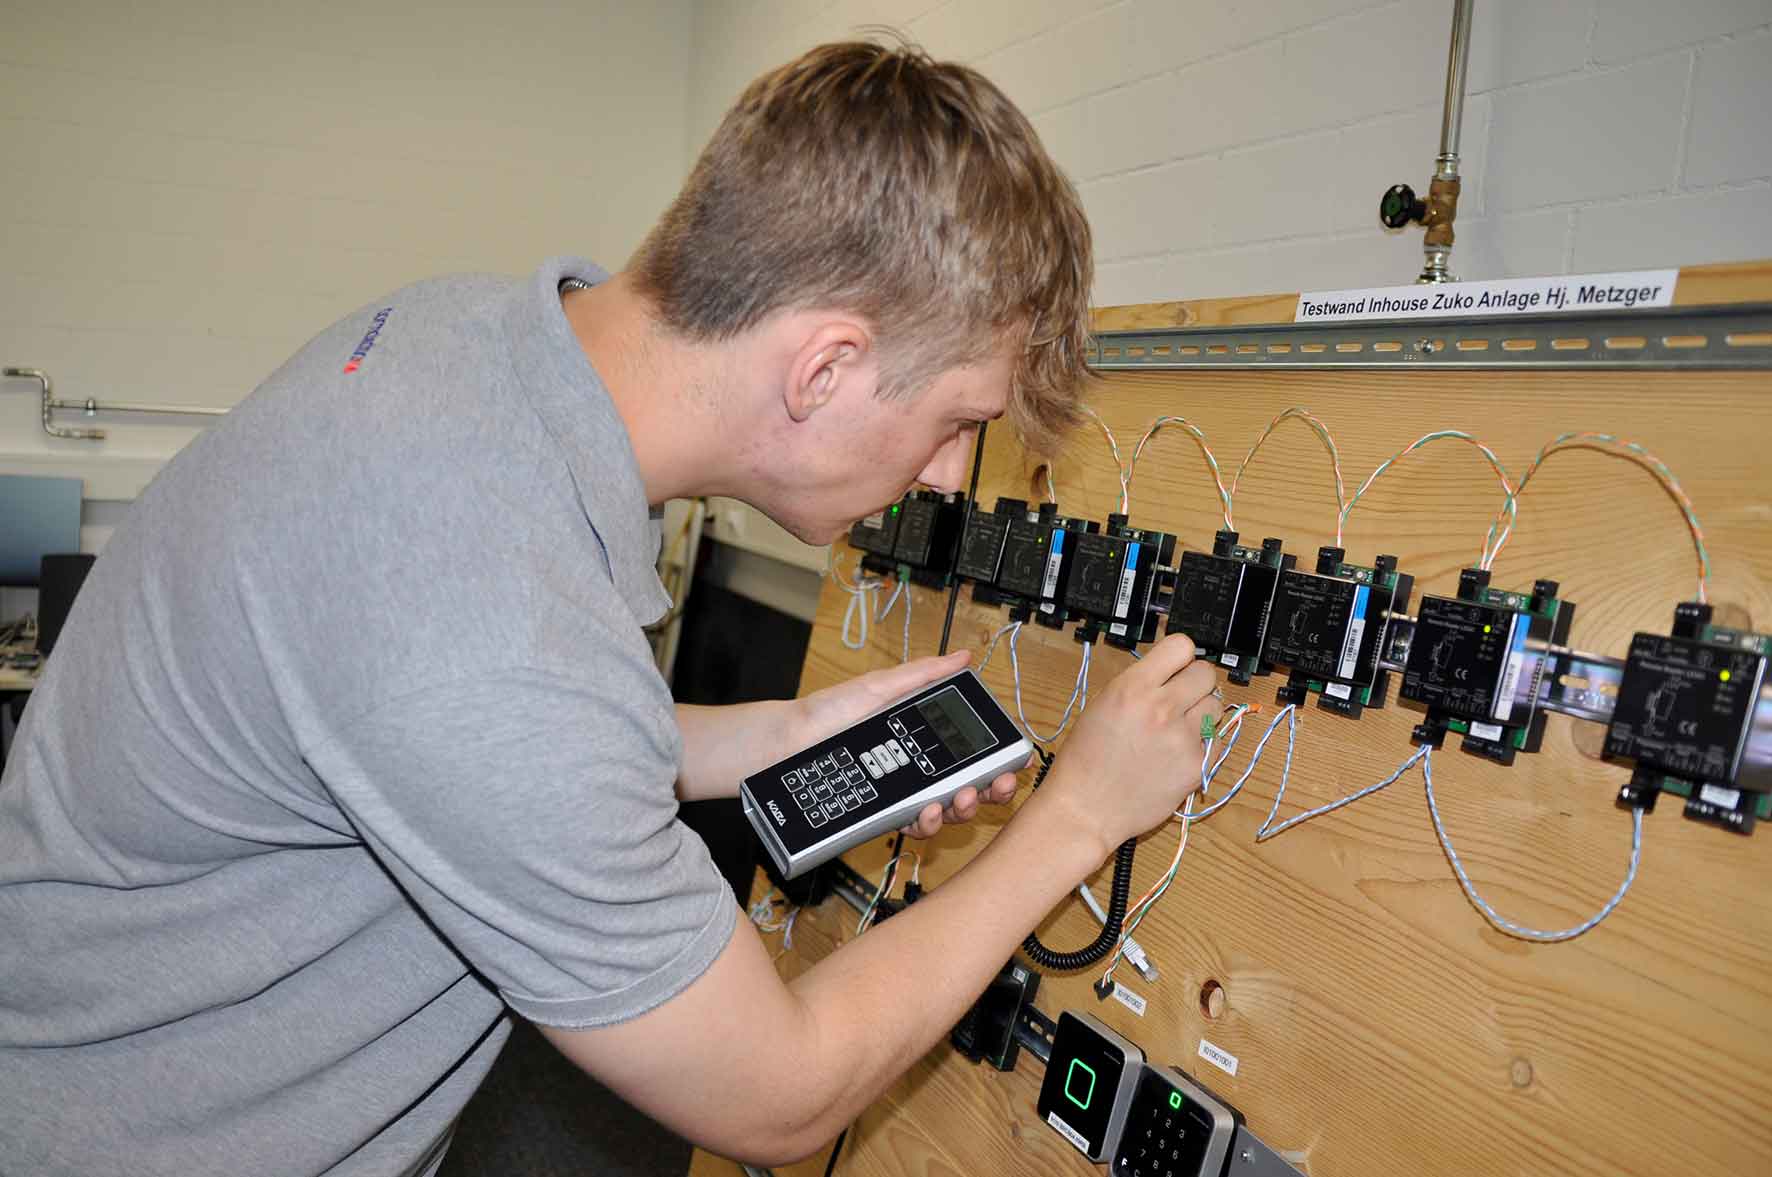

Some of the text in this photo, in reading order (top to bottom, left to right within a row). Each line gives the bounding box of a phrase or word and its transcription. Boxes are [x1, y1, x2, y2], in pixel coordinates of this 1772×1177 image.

[1302, 285, 1662, 316] Testwand Inhouse Zuko Anlage Hj. Metzger
[863, 785, 871, 793] 3
[766, 799, 786, 827] KABA
[1165, 1118, 1172, 1128] 2
[1179, 1128, 1185, 1139] 3
[1172, 1149, 1179, 1160] 6
[1152, 1160, 1159, 1169] 8
